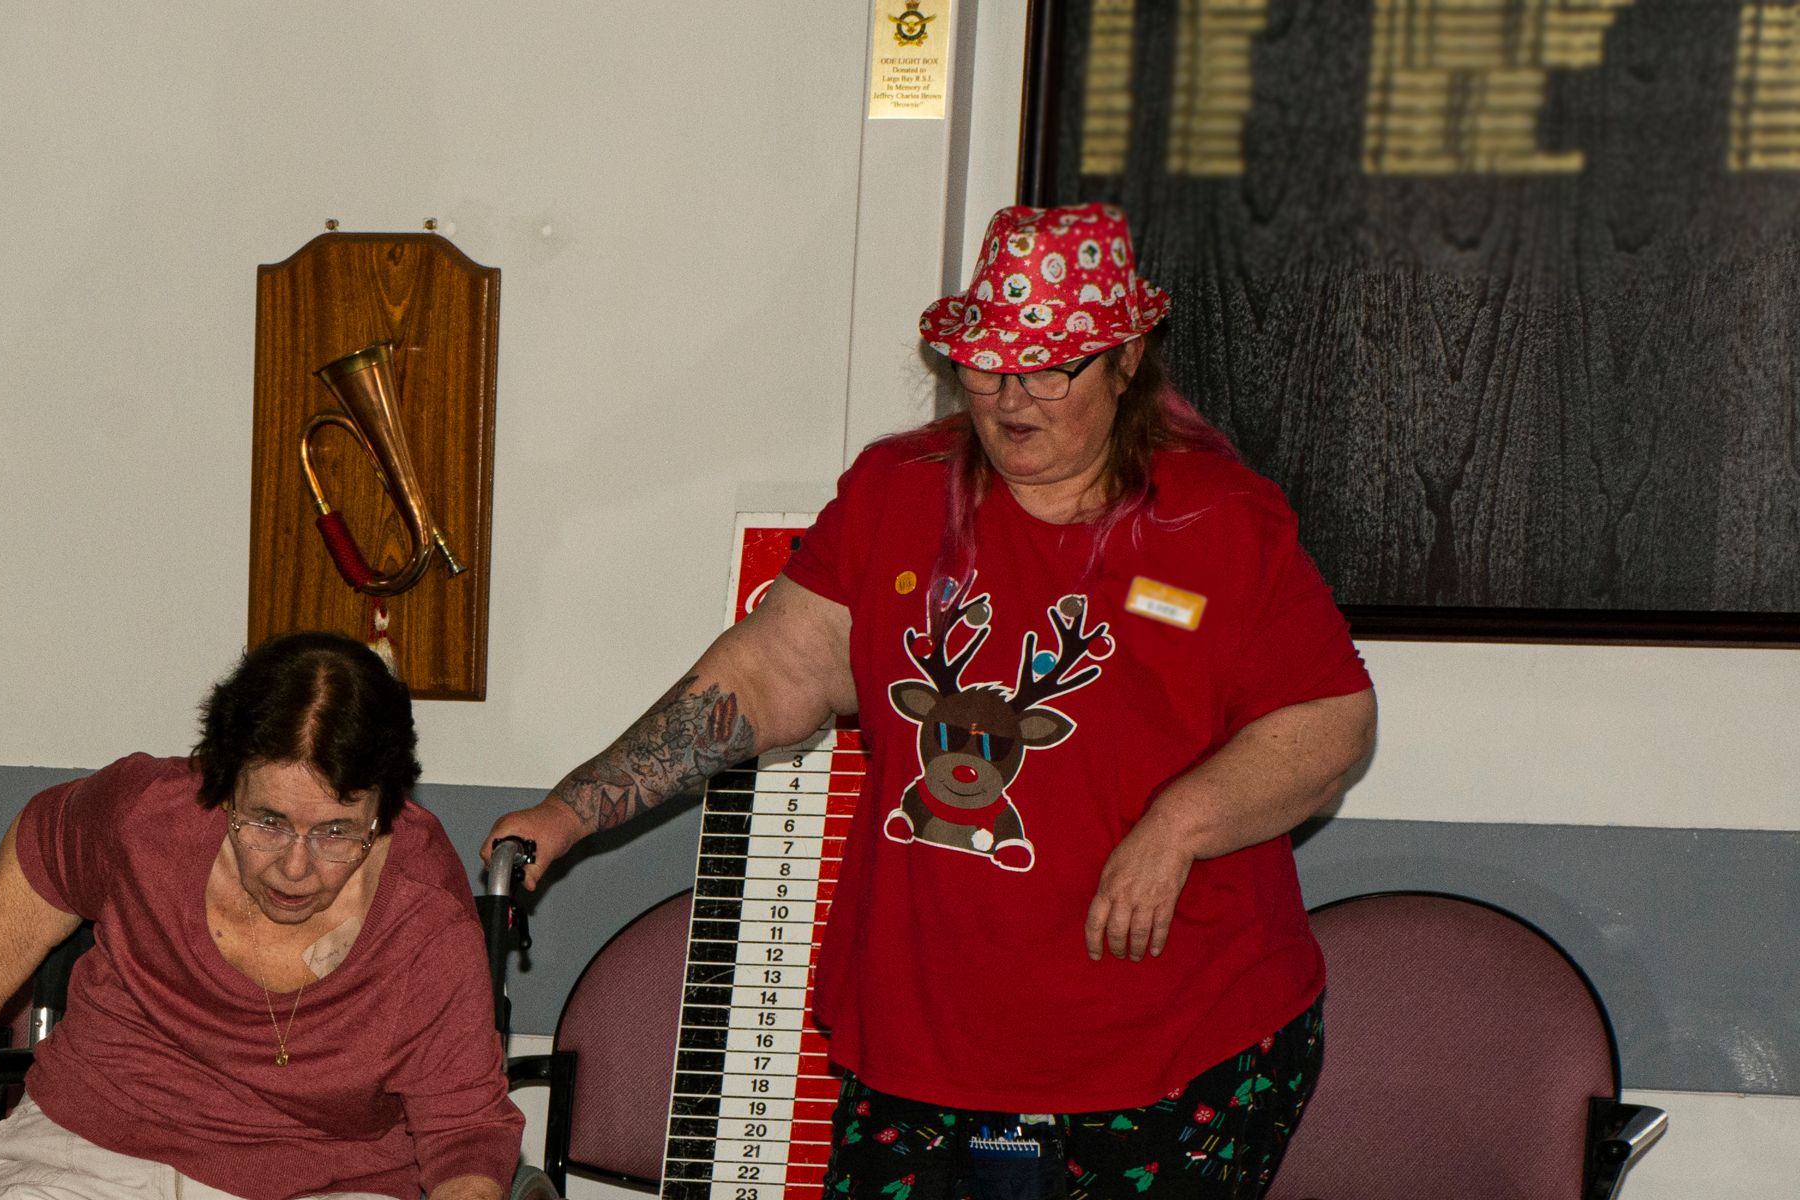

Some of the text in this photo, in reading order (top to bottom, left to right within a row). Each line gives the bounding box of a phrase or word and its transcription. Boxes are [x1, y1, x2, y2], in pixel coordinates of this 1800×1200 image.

[895, 84, 921, 92] Memory
[791, 755, 803, 768] 3
[789, 778, 800, 790] 4
[787, 799, 797, 812] 5
[784, 820, 795, 832] 6
[783, 841, 793, 854] 7
[779, 863, 790, 876] 8
[776, 885, 787, 897] 9
[770, 906, 788, 919] 10
[770, 927, 782, 940] 11
[765, 948, 783, 961] 12
[763, 970, 781, 983] 13
[760, 991, 777, 1005] 14
[758, 1012, 775, 1025] 15
[756, 1034, 773, 1047] 16
[753, 1057, 771, 1070] 17
[751, 1079, 769, 1092] 18
[749, 1102, 766, 1115] 19
[743, 1124, 767, 1137] 20
[742, 1145, 760, 1158] 21
[737, 1167, 759, 1180] 22
[735, 1188, 757, 1200] 23
